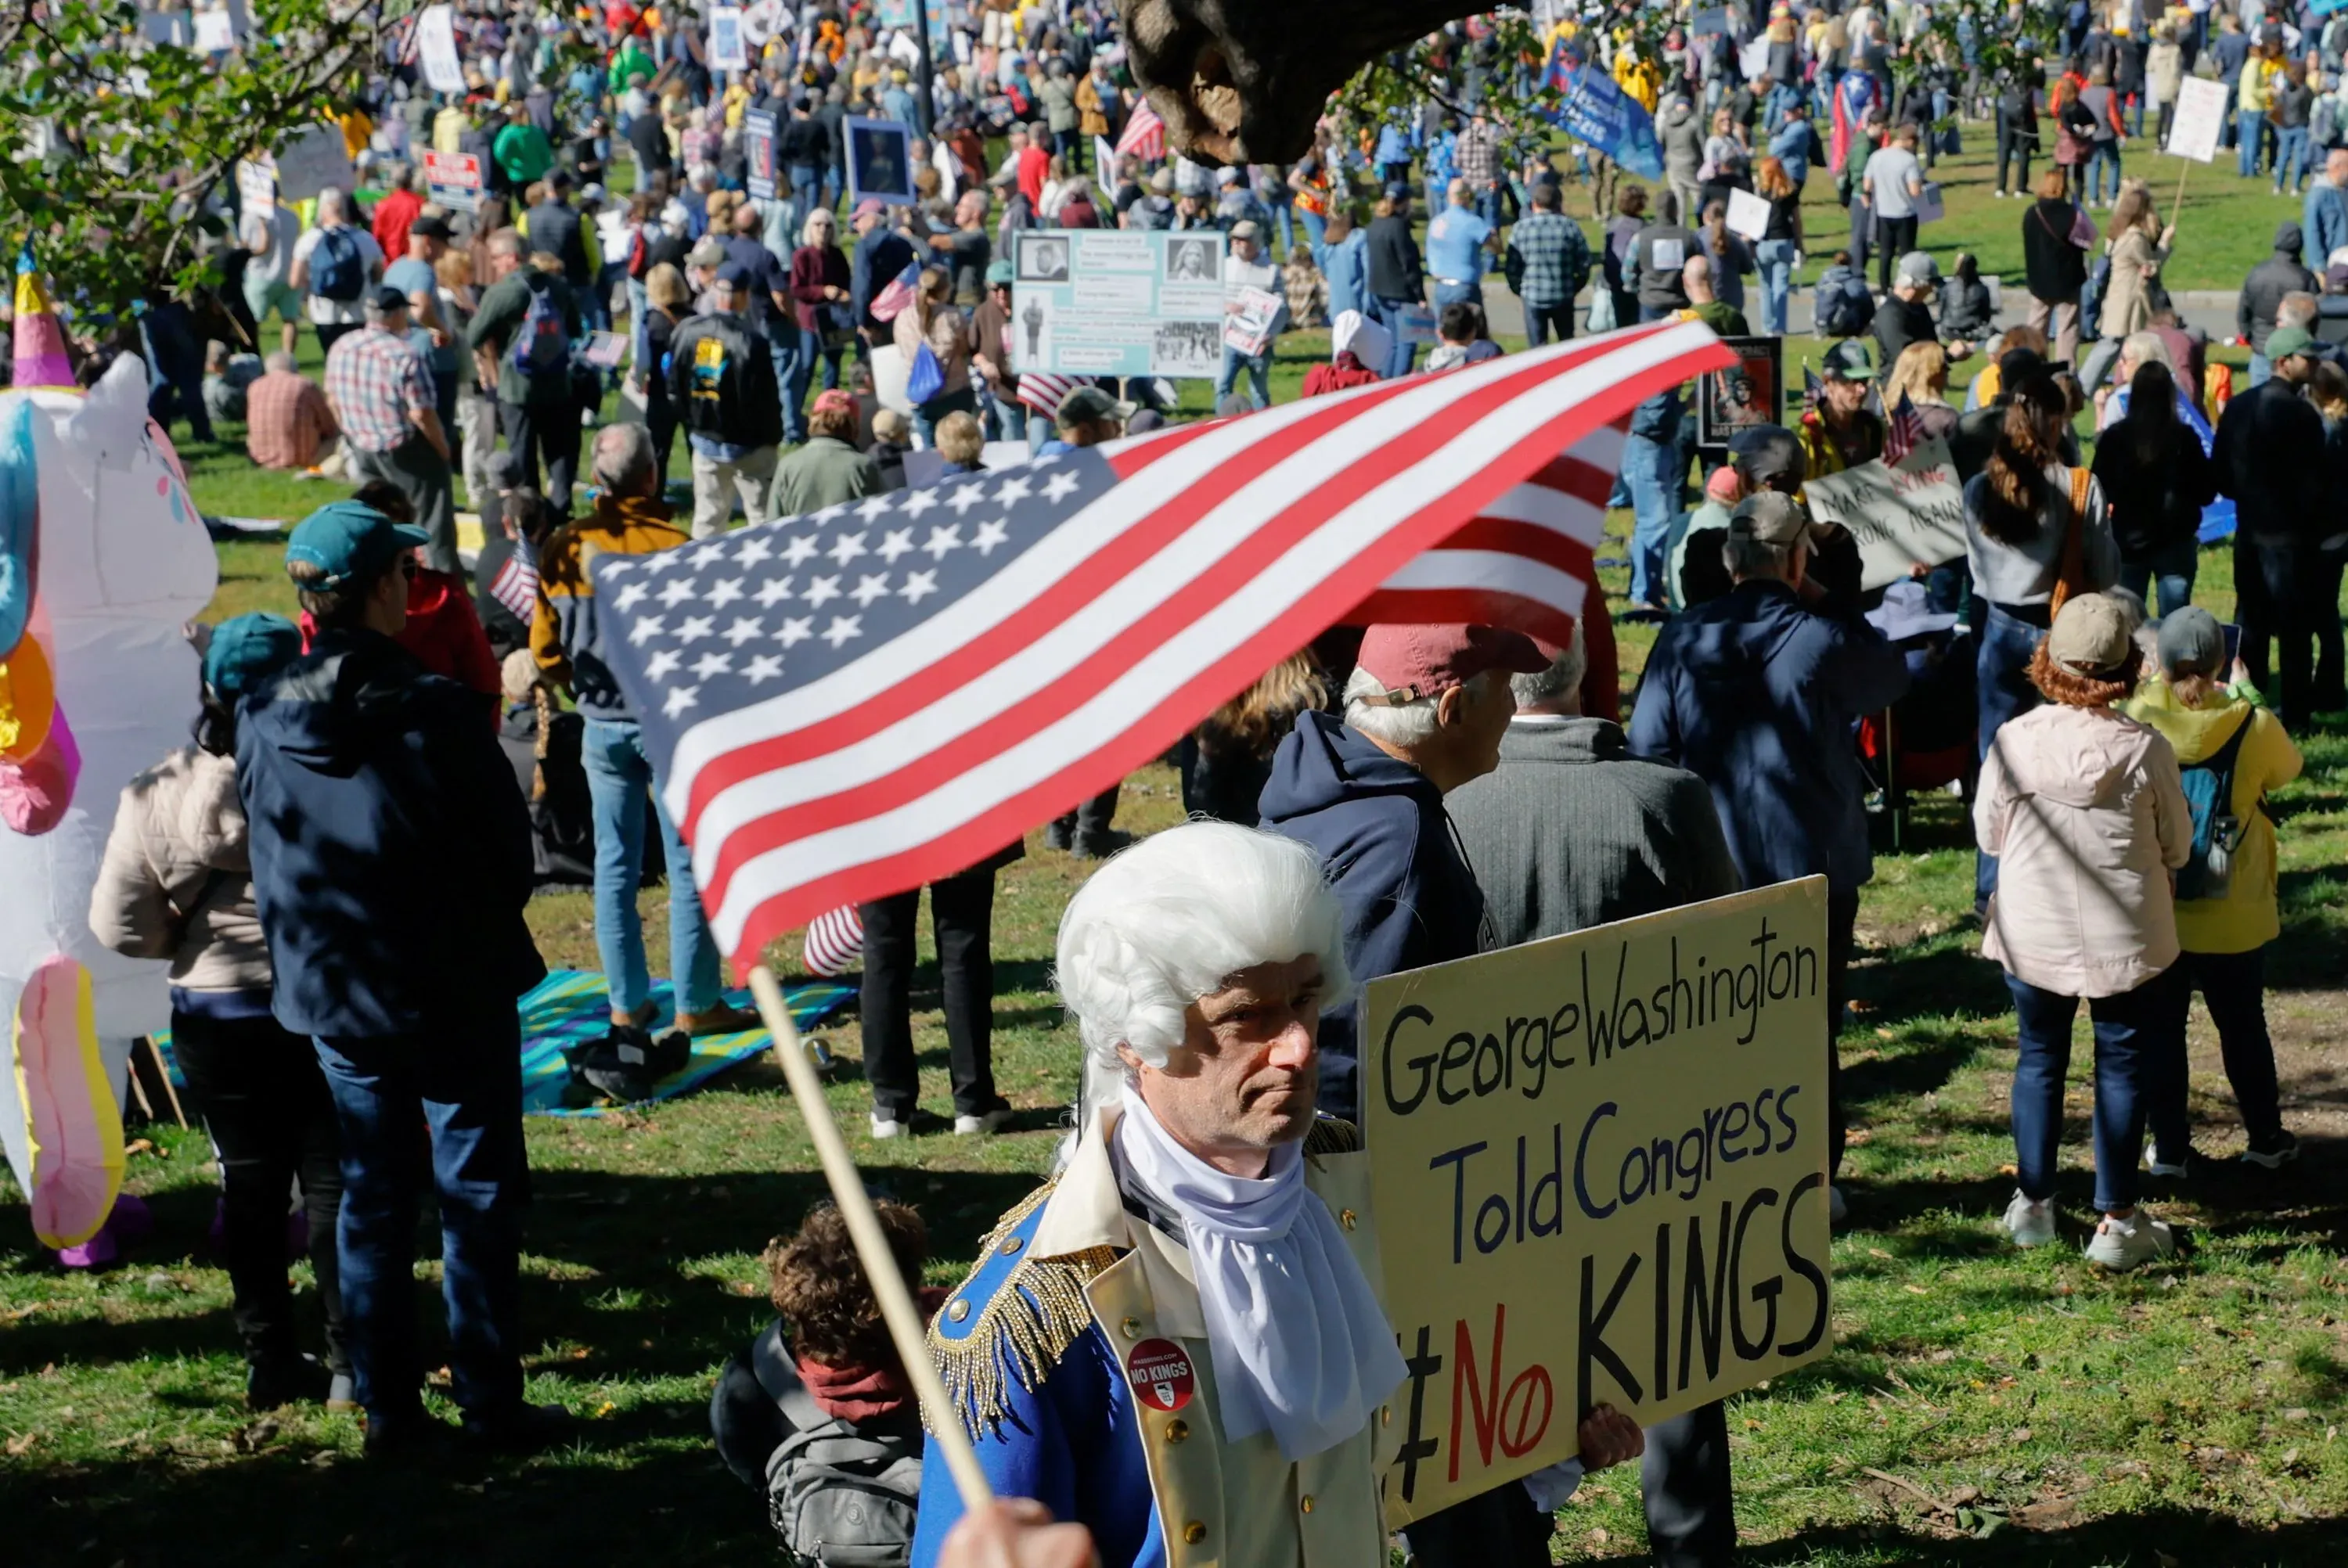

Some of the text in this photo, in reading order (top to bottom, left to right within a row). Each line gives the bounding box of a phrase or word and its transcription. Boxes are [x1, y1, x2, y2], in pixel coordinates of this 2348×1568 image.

[1822, 481, 1877, 517] MAKE
[1853, 497, 1964, 547] RONG AGAIN
[1382, 916, 1817, 1116] George Washington
[1429, 1084, 1800, 1264] Told Congress
[1576, 1172, 1828, 1418] KINGS
[1130, 1361, 1188, 1384] NO KINGS
